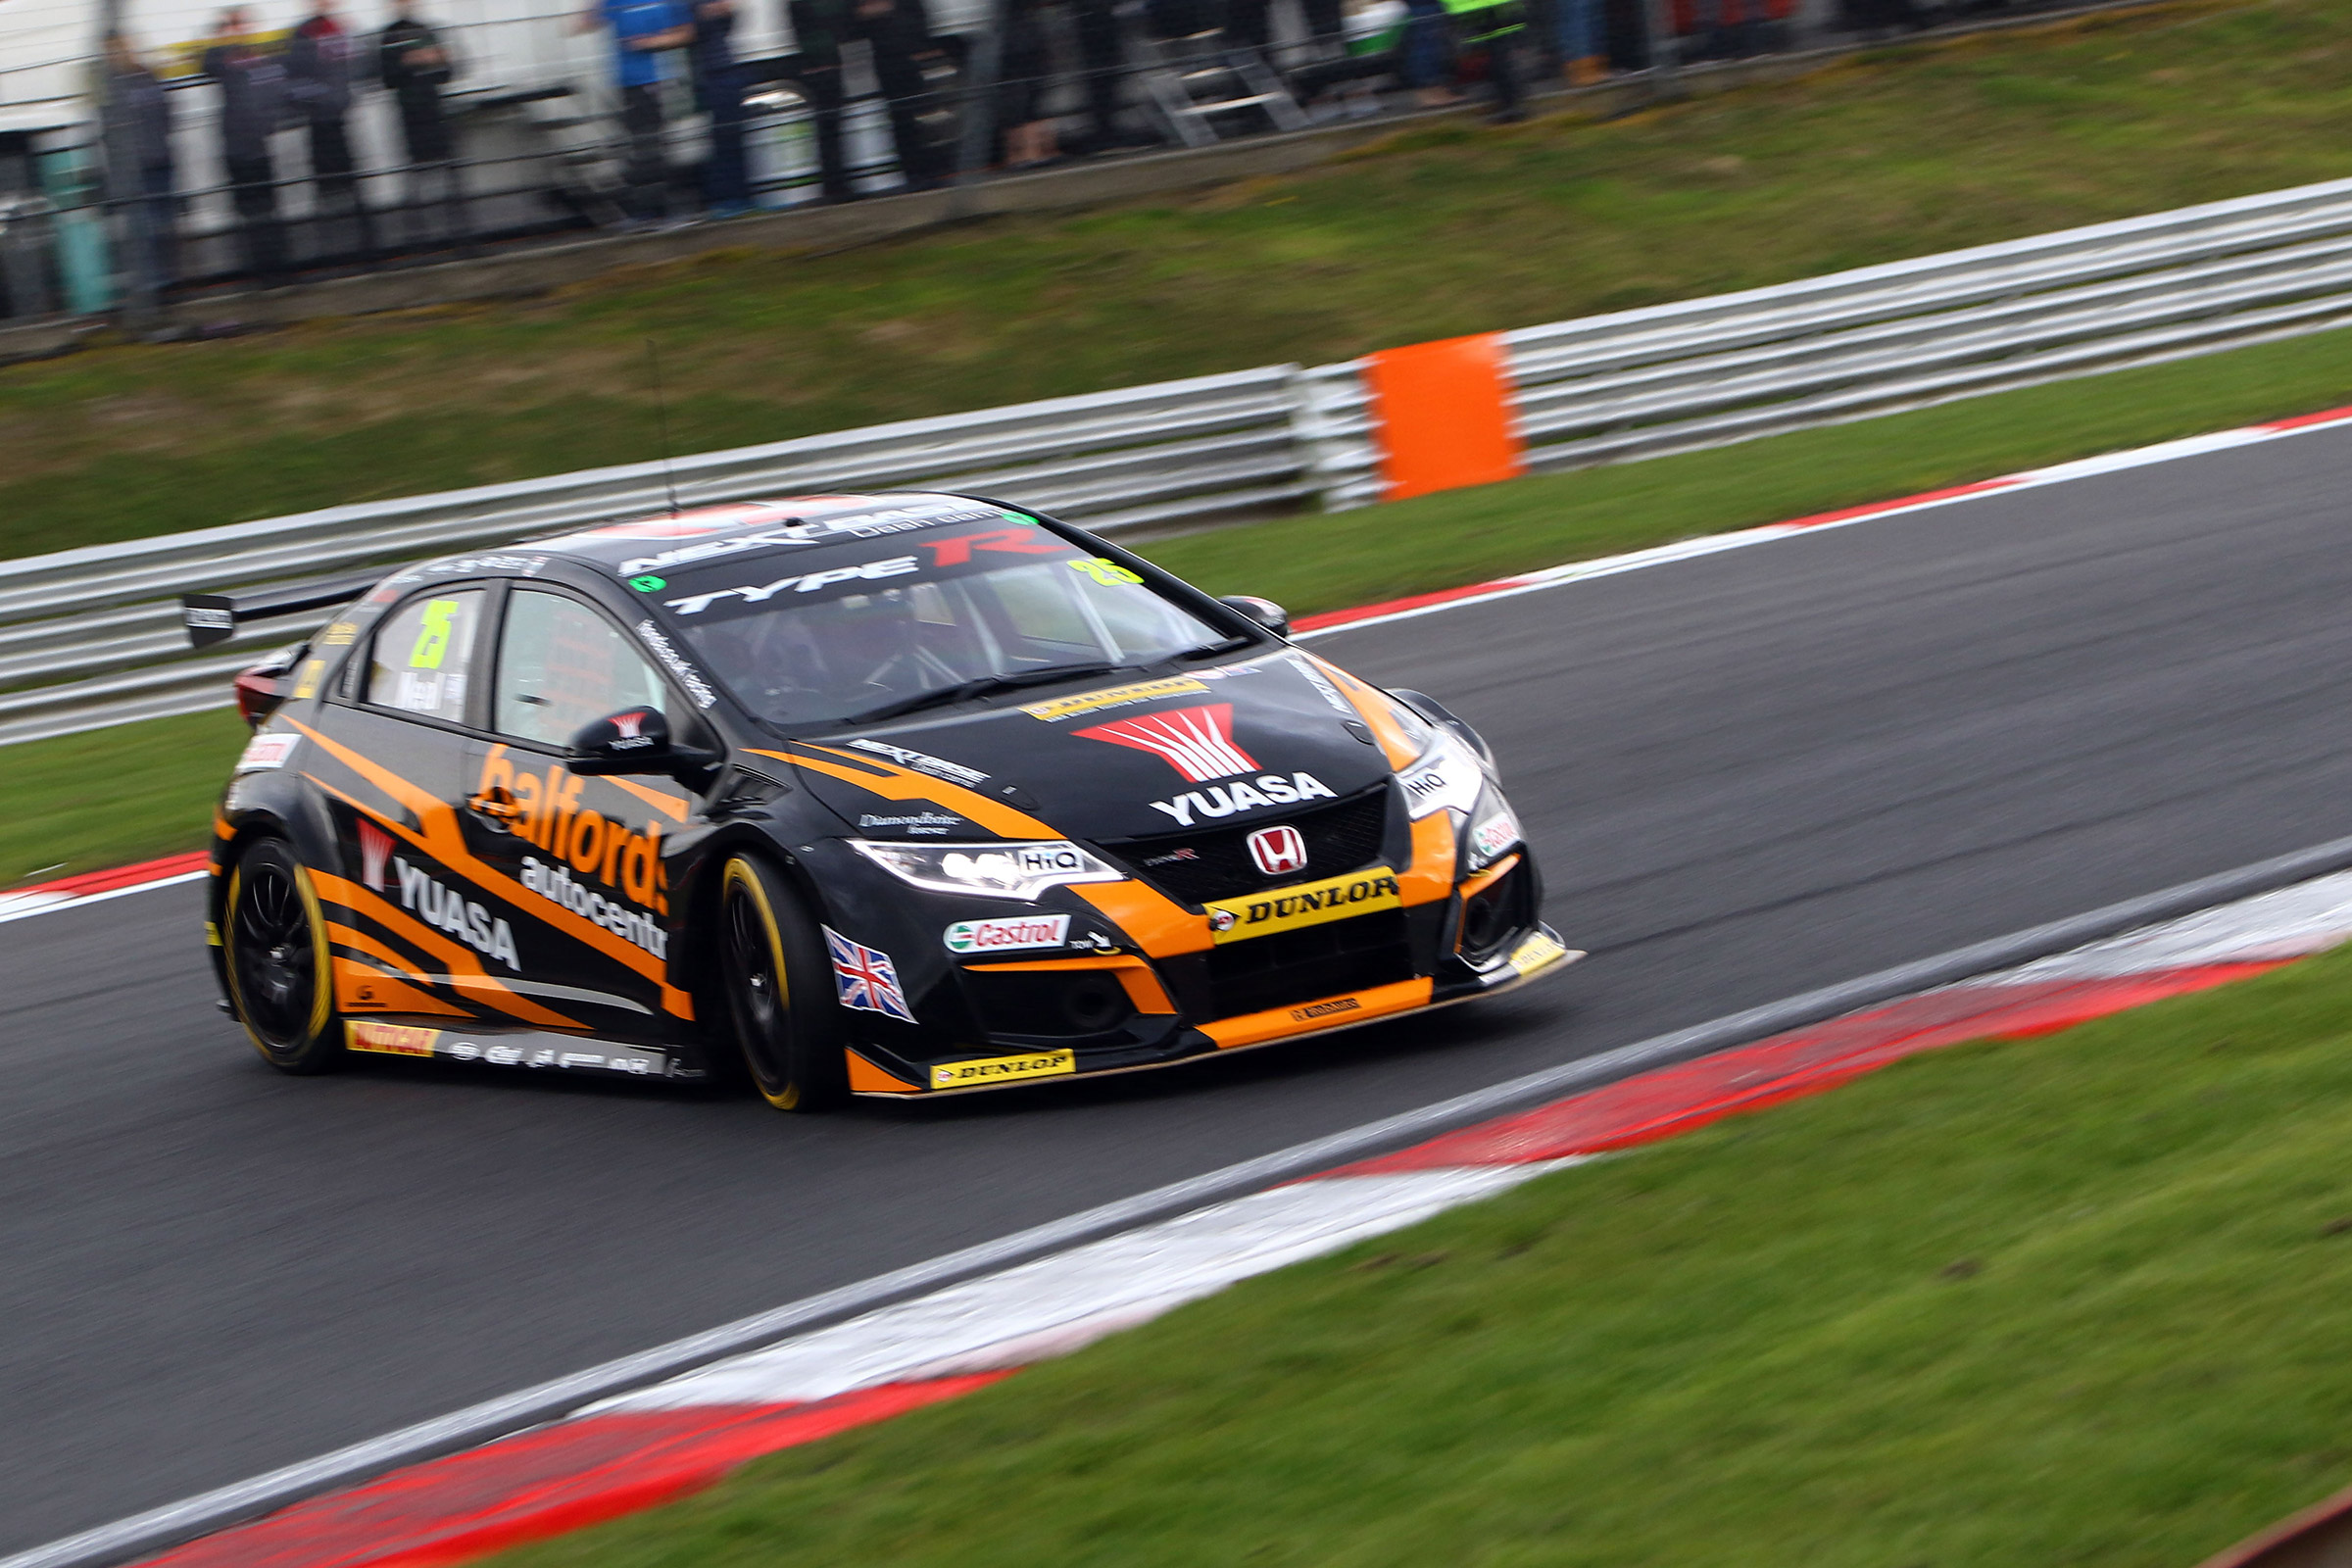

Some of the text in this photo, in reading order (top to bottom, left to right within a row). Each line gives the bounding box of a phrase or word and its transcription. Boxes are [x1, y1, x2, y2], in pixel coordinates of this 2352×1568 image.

[663, 527, 1070, 615] TYPE R
[1065, 557, 1145, 587] 25
[1148, 771, 1339, 827] YUASA
[393, 856, 522, 972] YUASA
[1246, 876, 1399, 924] DUNLOP
[974, 919, 1061, 948] Castrol
[956, 1055, 1067, 1079] DUNLOP
